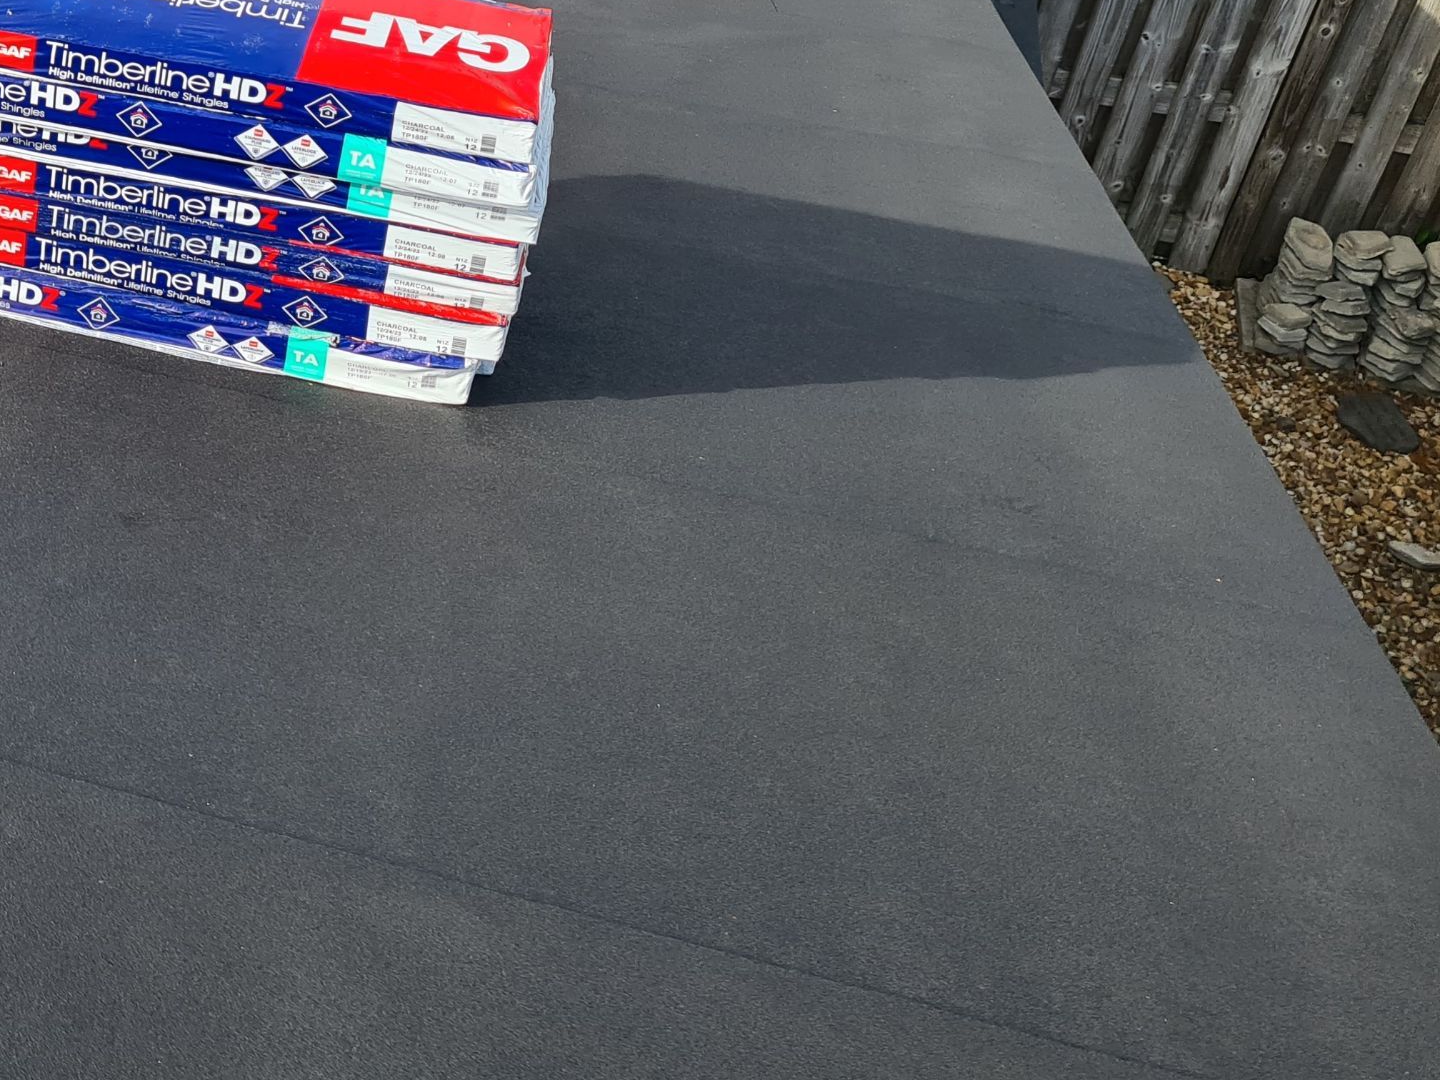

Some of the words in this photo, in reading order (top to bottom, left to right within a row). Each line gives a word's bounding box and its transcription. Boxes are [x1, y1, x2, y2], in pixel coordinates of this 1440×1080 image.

[330, 11, 530, 73] GAF
[48, 66, 75, 80] High
[182, 91, 229, 109] Shingles
[0, 101, 45, 118] Shingles
[402, 120, 446, 133] CHARCOAL
[12, 136, 57, 151] Shingles
[465, 143, 477, 151] 12
[349, 151, 376, 170] TA
[51, 228, 77, 241] High
[394, 238, 437, 252] CHARCOAL
[454, 263, 467, 272] 12
[39, 262, 65, 276] High
[166, 289, 212, 306] Shingles
[394, 279, 436, 293] CHARCOAL
[376, 320, 418, 334] CHARCOAL
[435, 345, 448, 353] 12
[292, 350, 319, 367] TA
